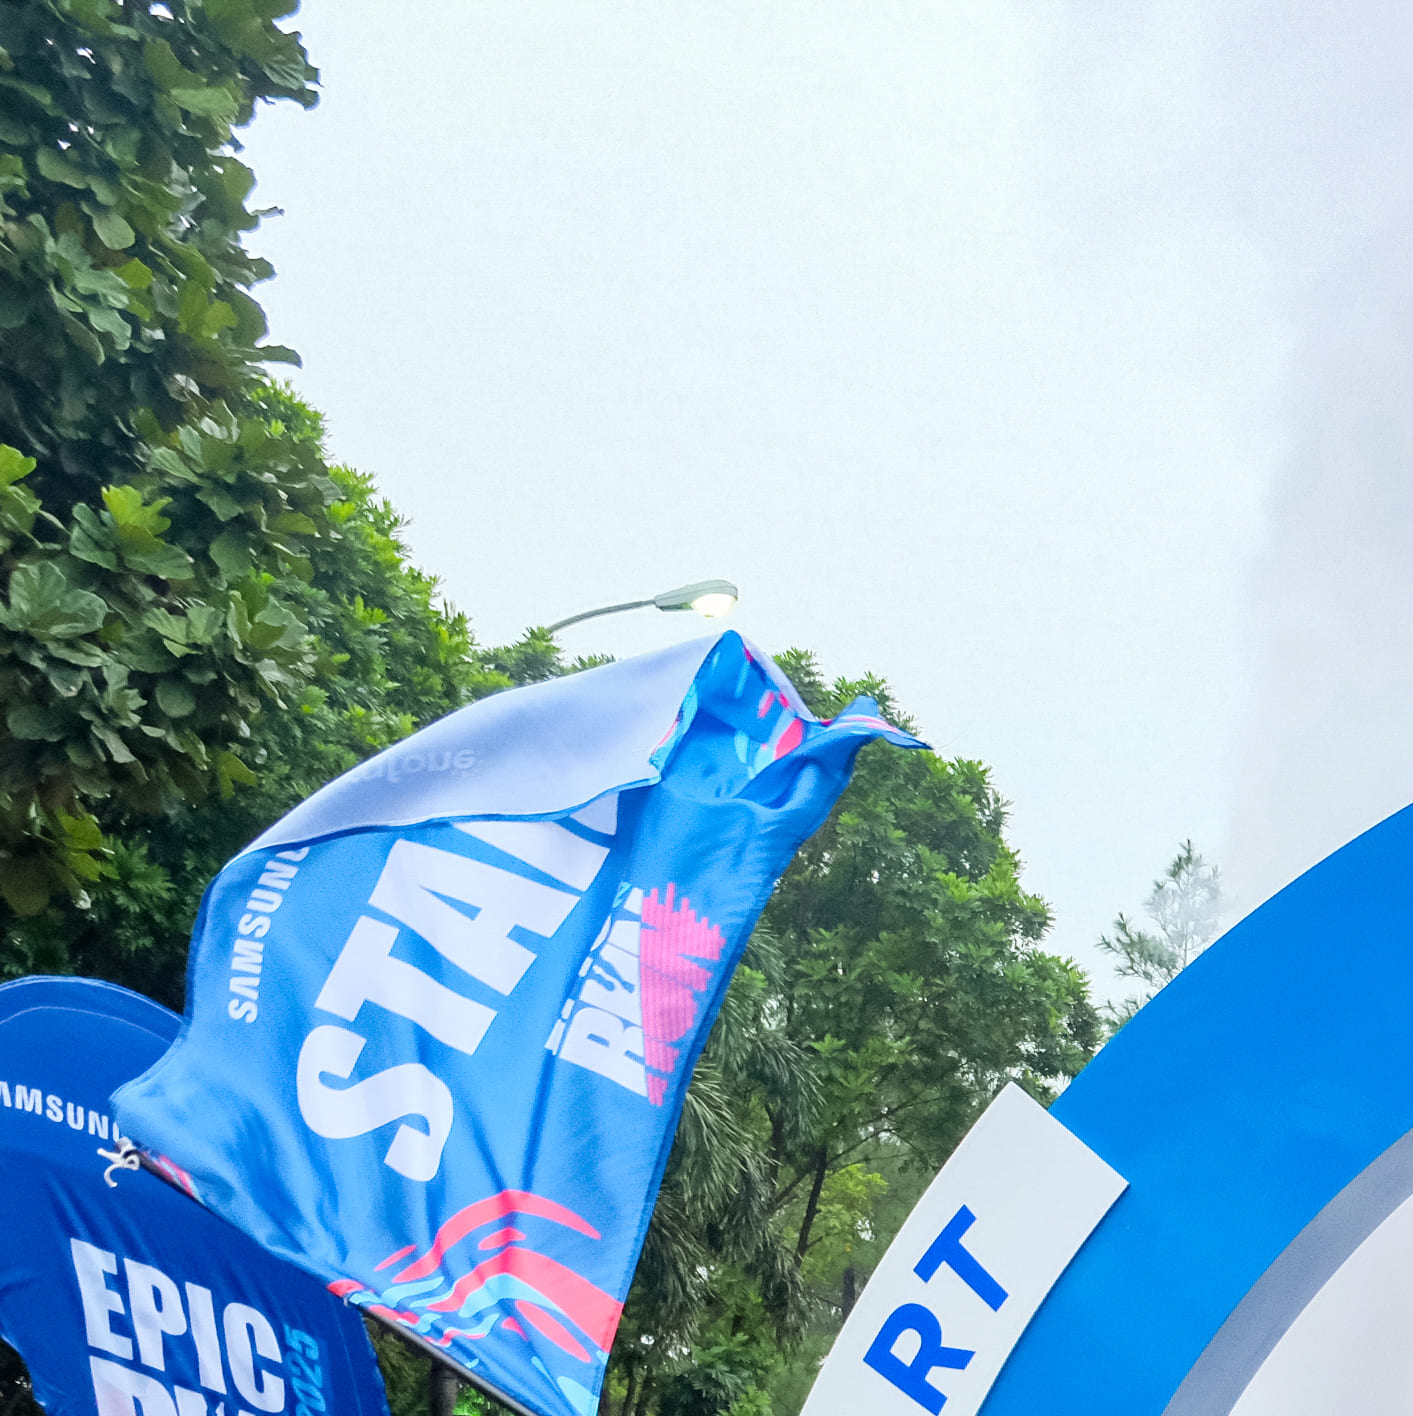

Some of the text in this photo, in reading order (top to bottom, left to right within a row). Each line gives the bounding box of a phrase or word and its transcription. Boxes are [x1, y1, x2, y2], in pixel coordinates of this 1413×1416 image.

[228, 846, 309, 1024] SAMSUN
[297, 793, 618, 1181] STA
[0, 1081, 120, 1142] AMSUN
[70, 1238, 285, 1413] EPIC
